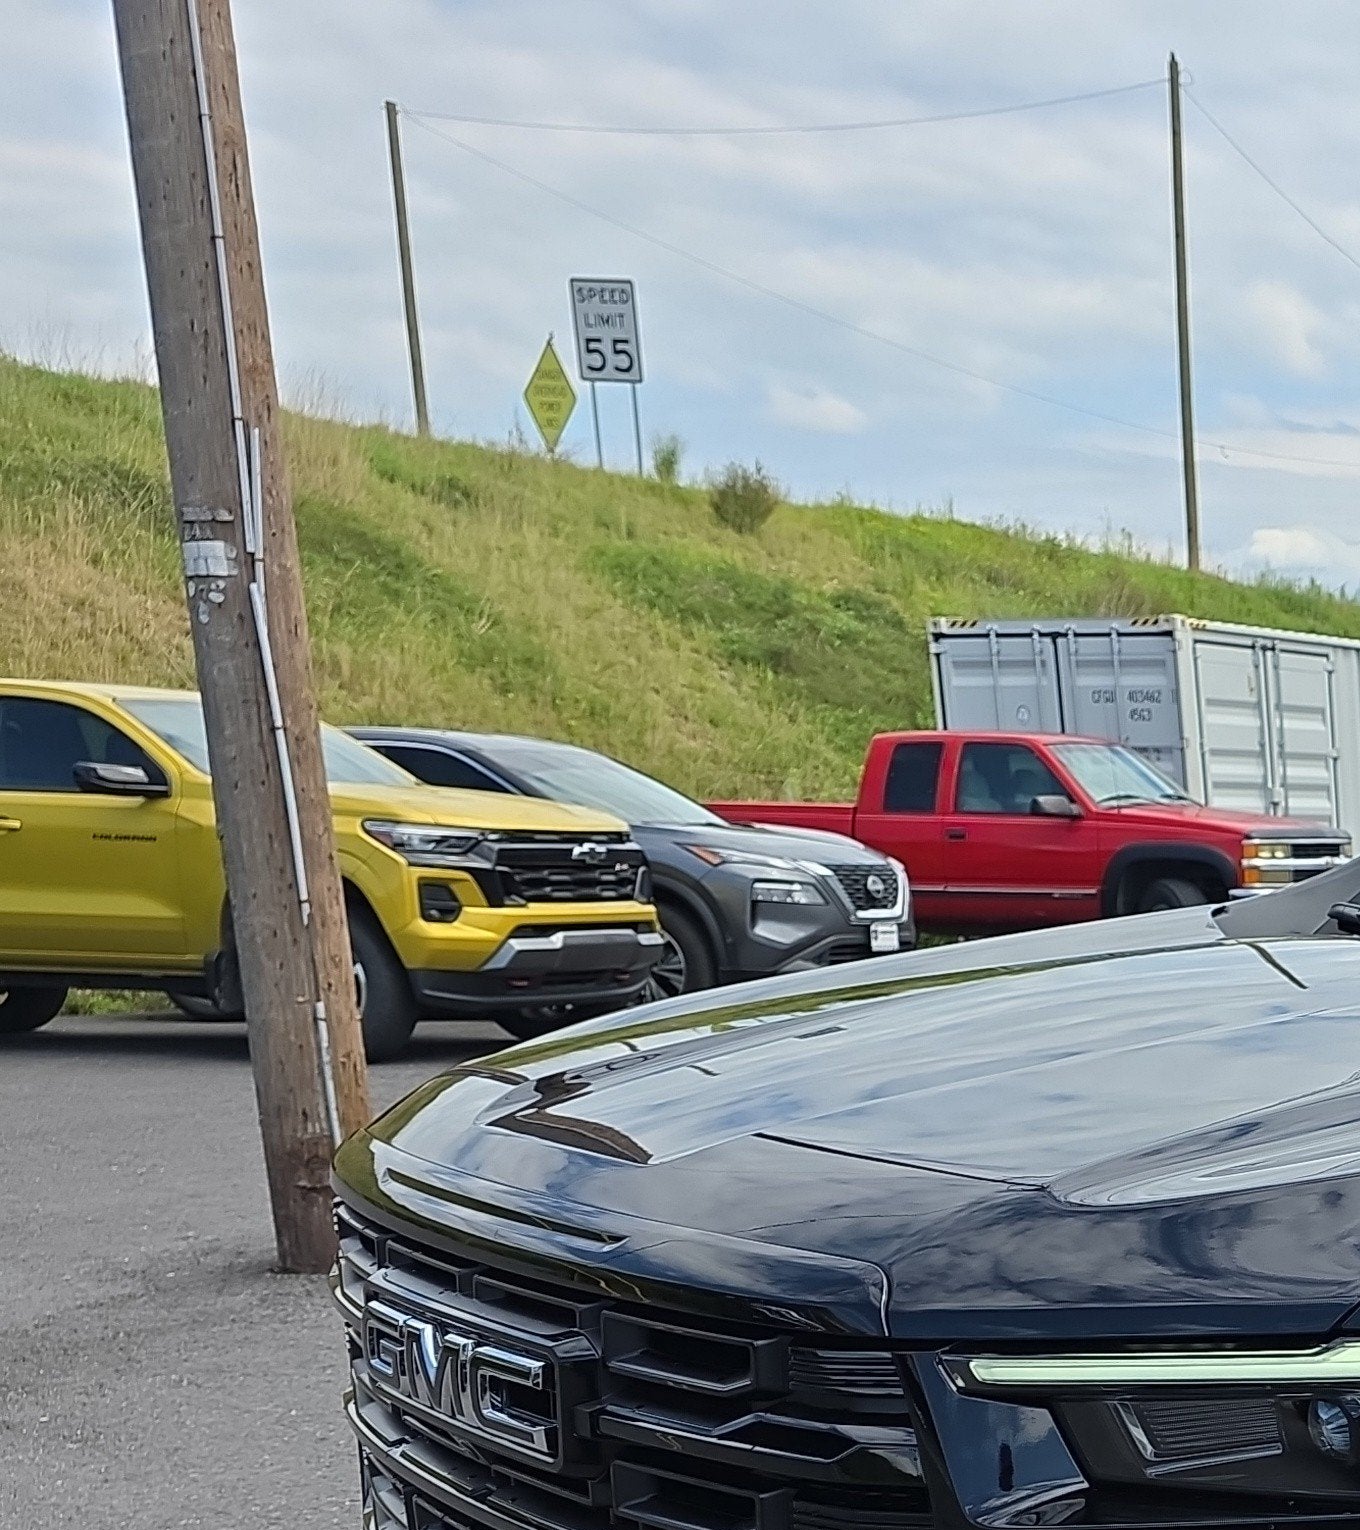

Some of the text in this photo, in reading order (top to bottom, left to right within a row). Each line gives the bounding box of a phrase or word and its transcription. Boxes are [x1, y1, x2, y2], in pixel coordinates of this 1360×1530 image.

[576, 287, 630, 304] SPEED
[583, 313, 625, 329] LIMIT
[585, 338, 633, 372] 55
[361, 1300, 555, 1453] GMC
